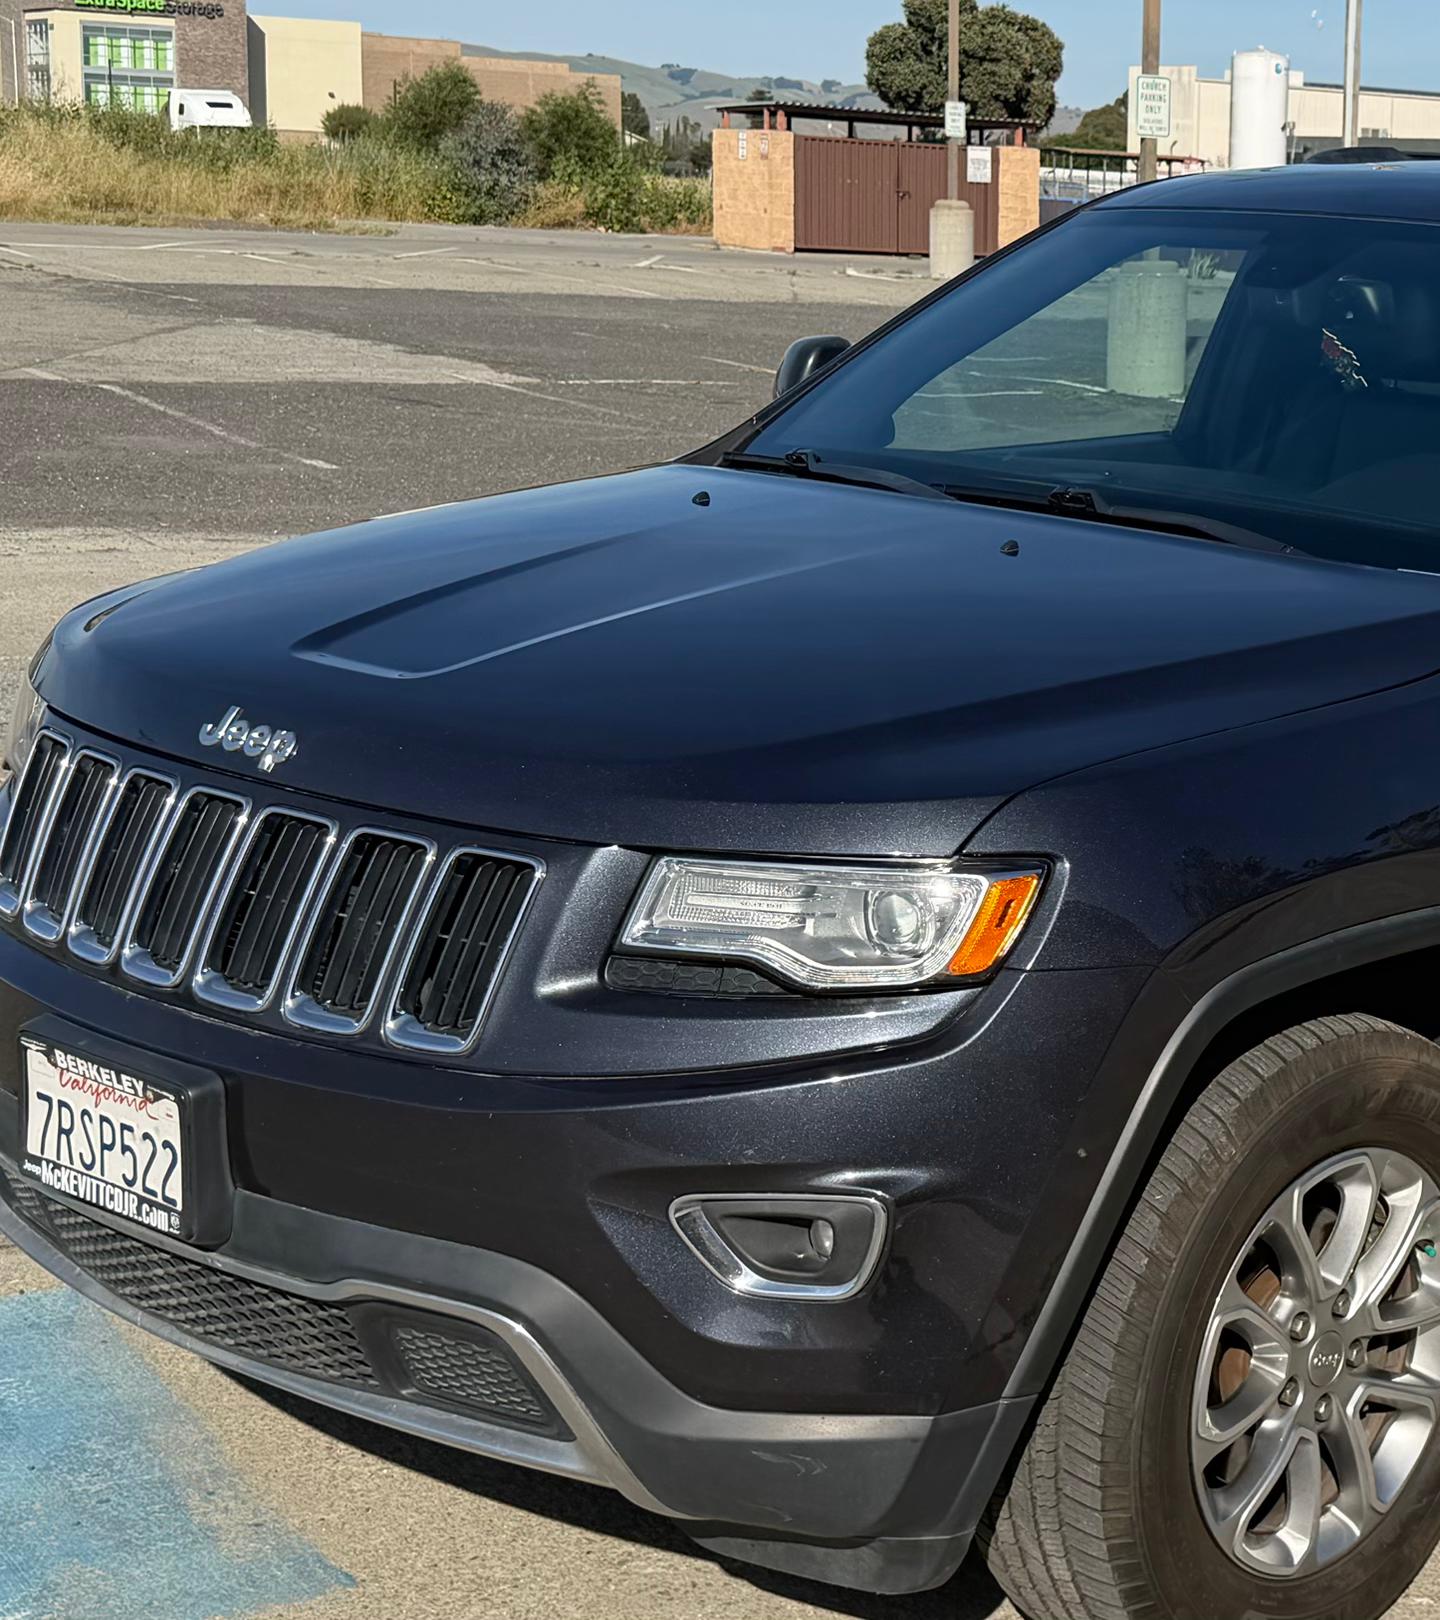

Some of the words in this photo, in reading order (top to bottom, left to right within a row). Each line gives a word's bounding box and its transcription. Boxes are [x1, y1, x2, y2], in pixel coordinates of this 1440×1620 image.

[165, 1, 224, 19] Storage
[199, 705, 298, 773] Jeep
[54, 1048, 145, 1097] BERKELEY
[58, 1069, 159, 1120] California
[36, 1091, 178, 1208] 7RSP522
